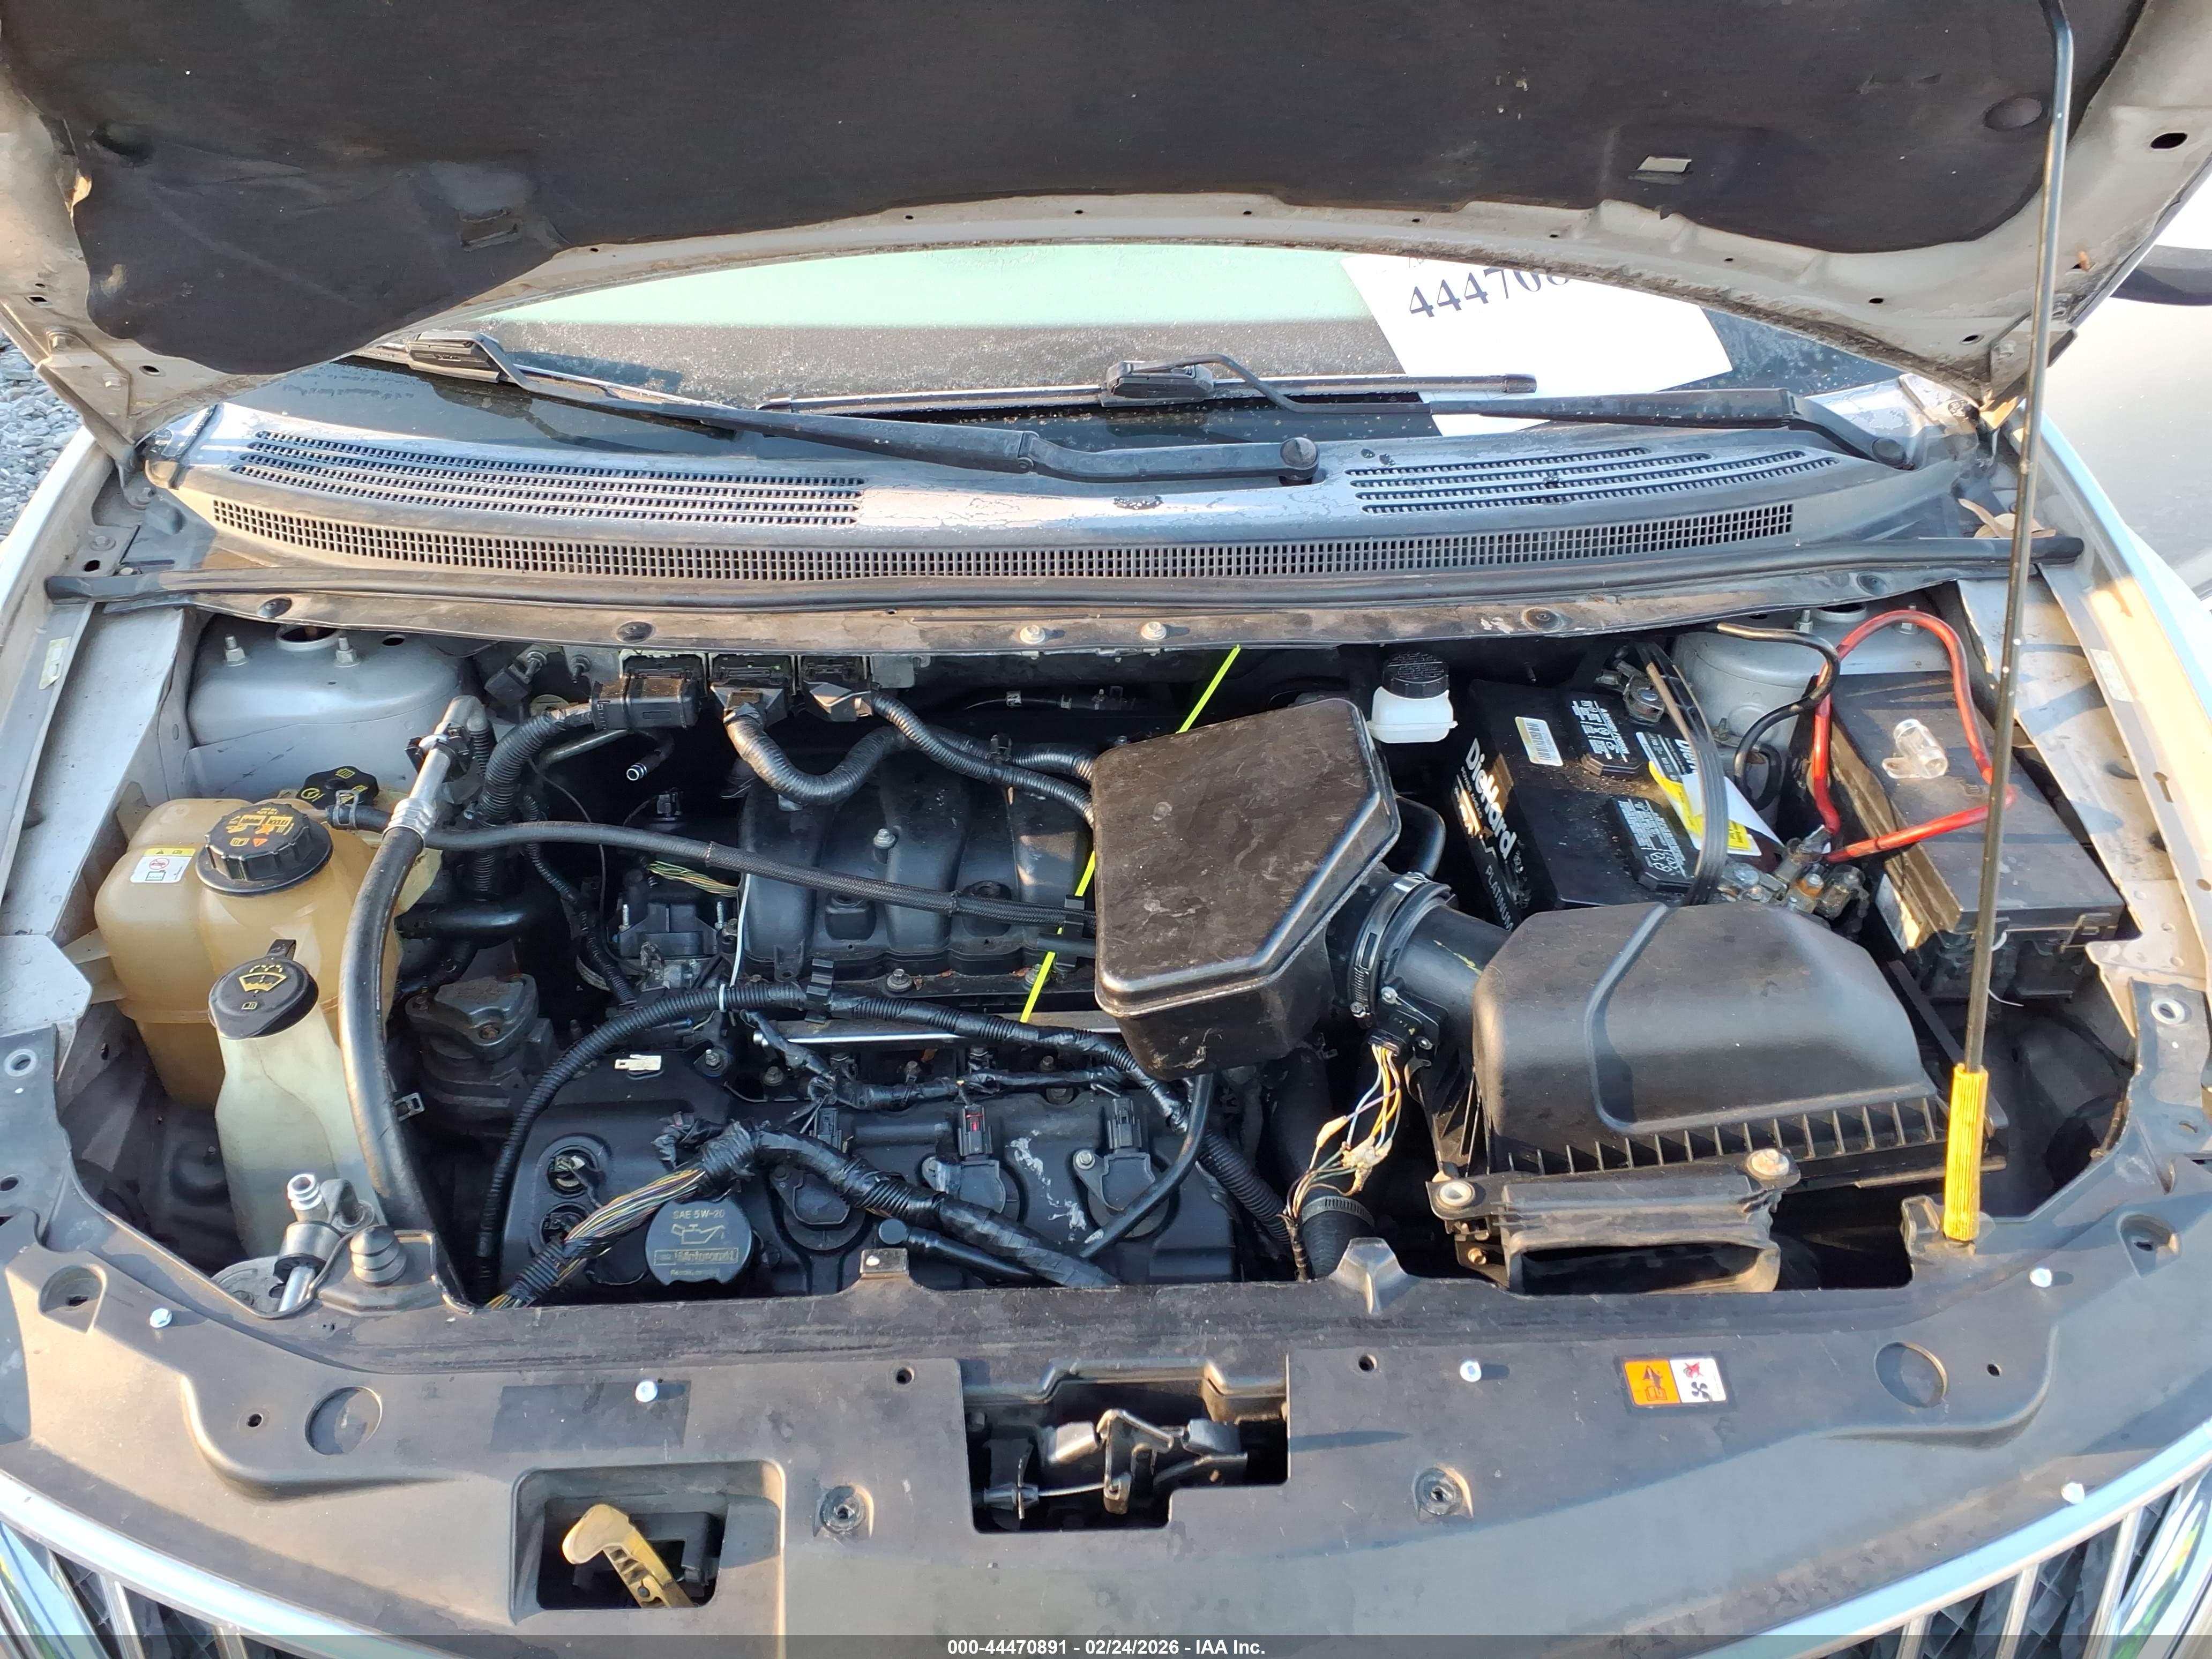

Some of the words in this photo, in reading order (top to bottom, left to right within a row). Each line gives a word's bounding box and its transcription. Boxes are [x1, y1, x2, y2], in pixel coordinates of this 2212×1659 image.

[1466, 737, 1518, 860] DieHard
[1485, 865, 1514, 931] PLATINUM
[672, 1209, 692, 1219] SAE
[693, 1208, 726, 1218] 5W-20
